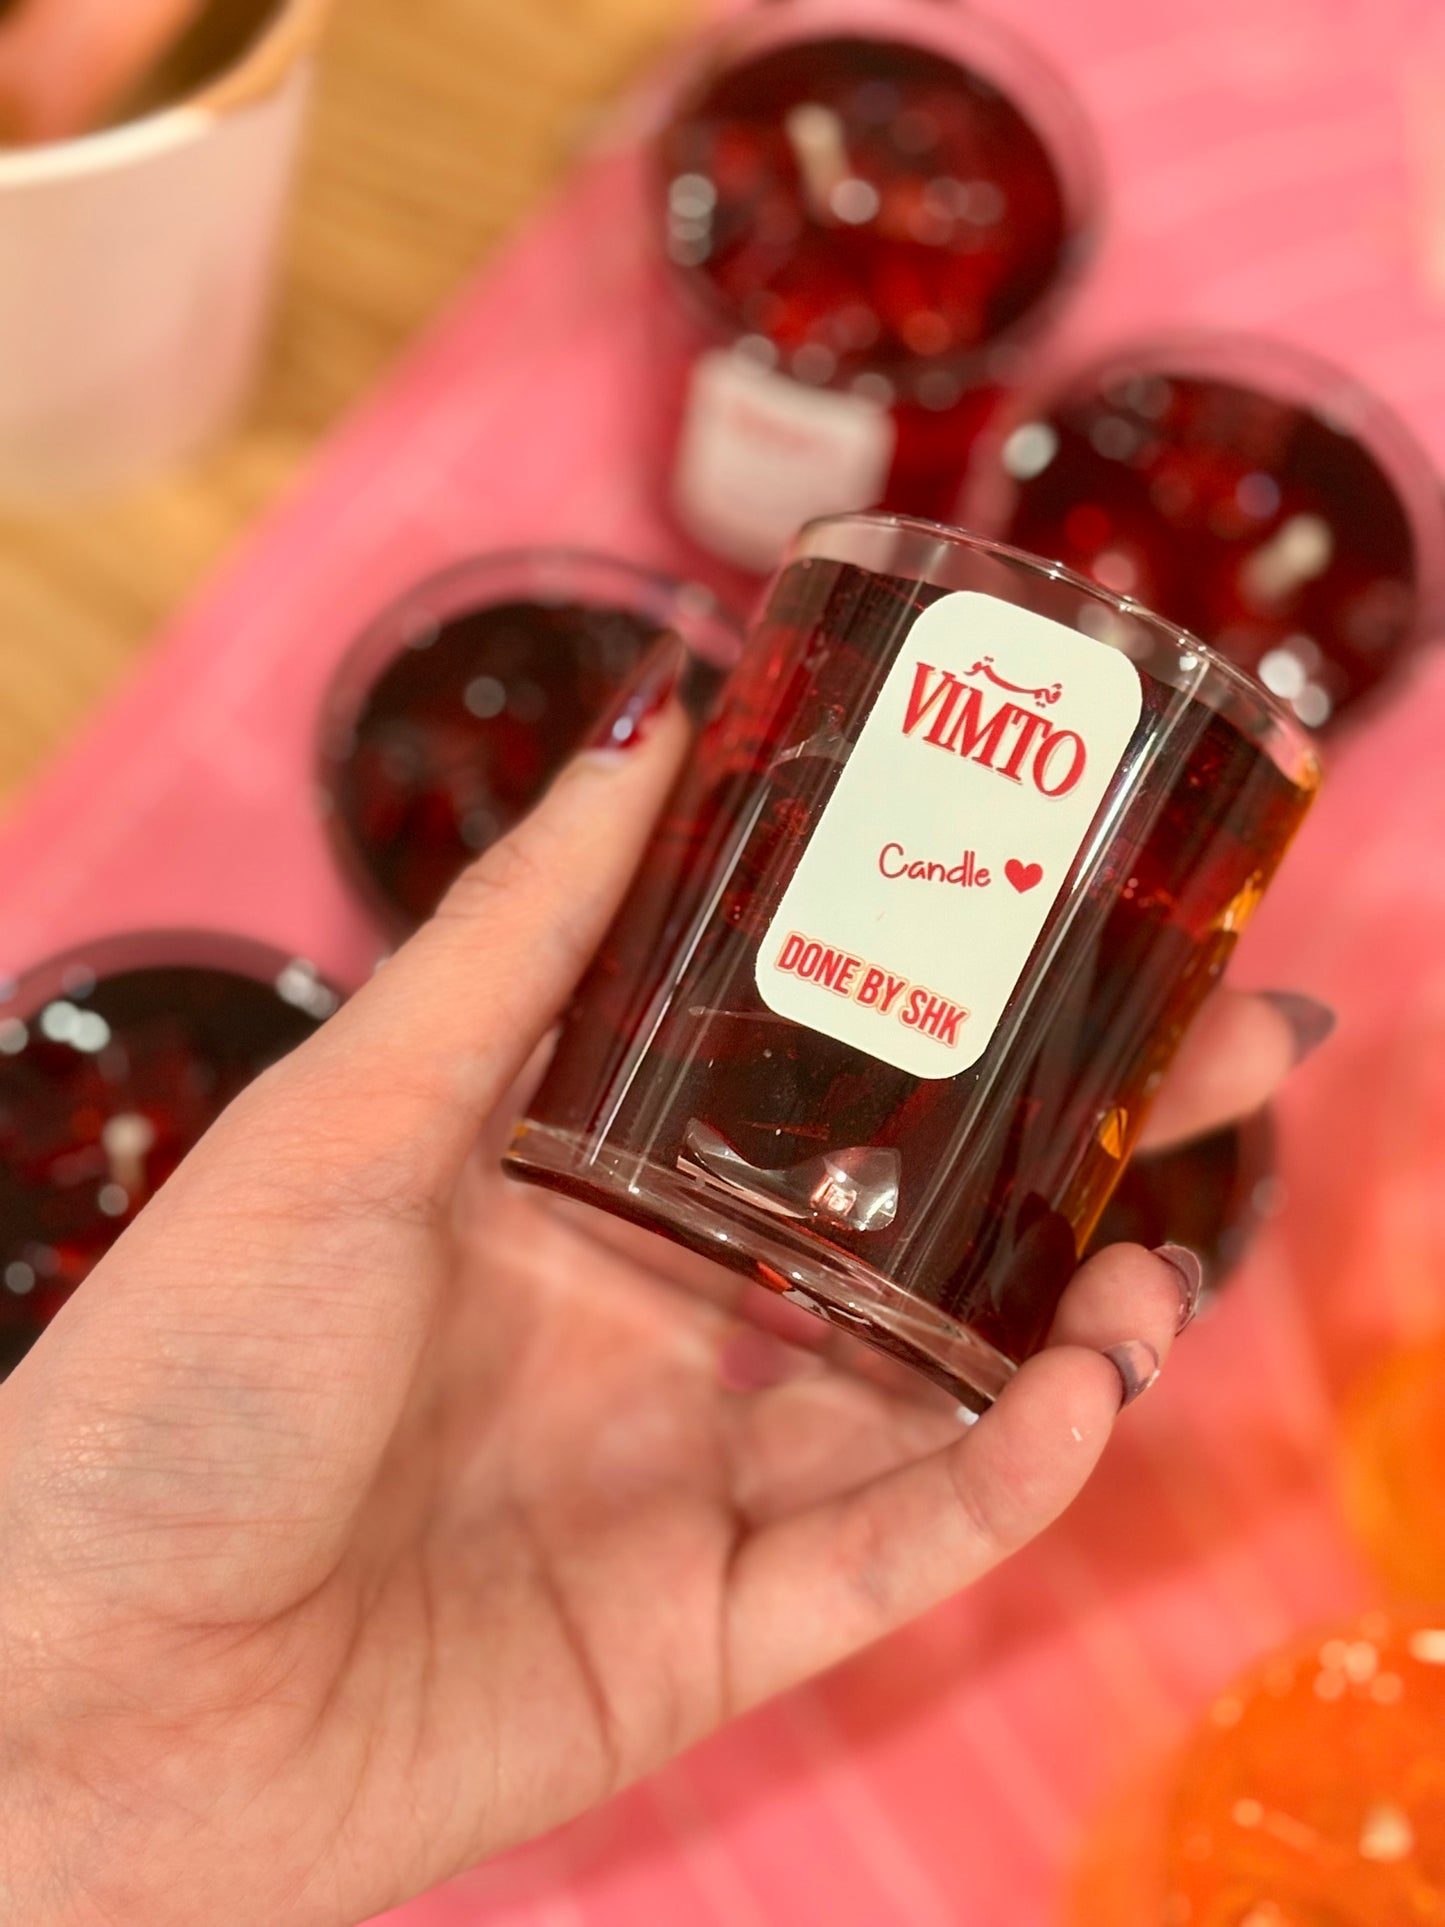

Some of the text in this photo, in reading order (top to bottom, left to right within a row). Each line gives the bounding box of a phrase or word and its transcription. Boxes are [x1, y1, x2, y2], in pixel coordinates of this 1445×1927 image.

[902, 661, 1086, 797] VIMTO
[878, 843, 991, 888] Candle
[777, 934, 967, 1045] DONE BY SHK
